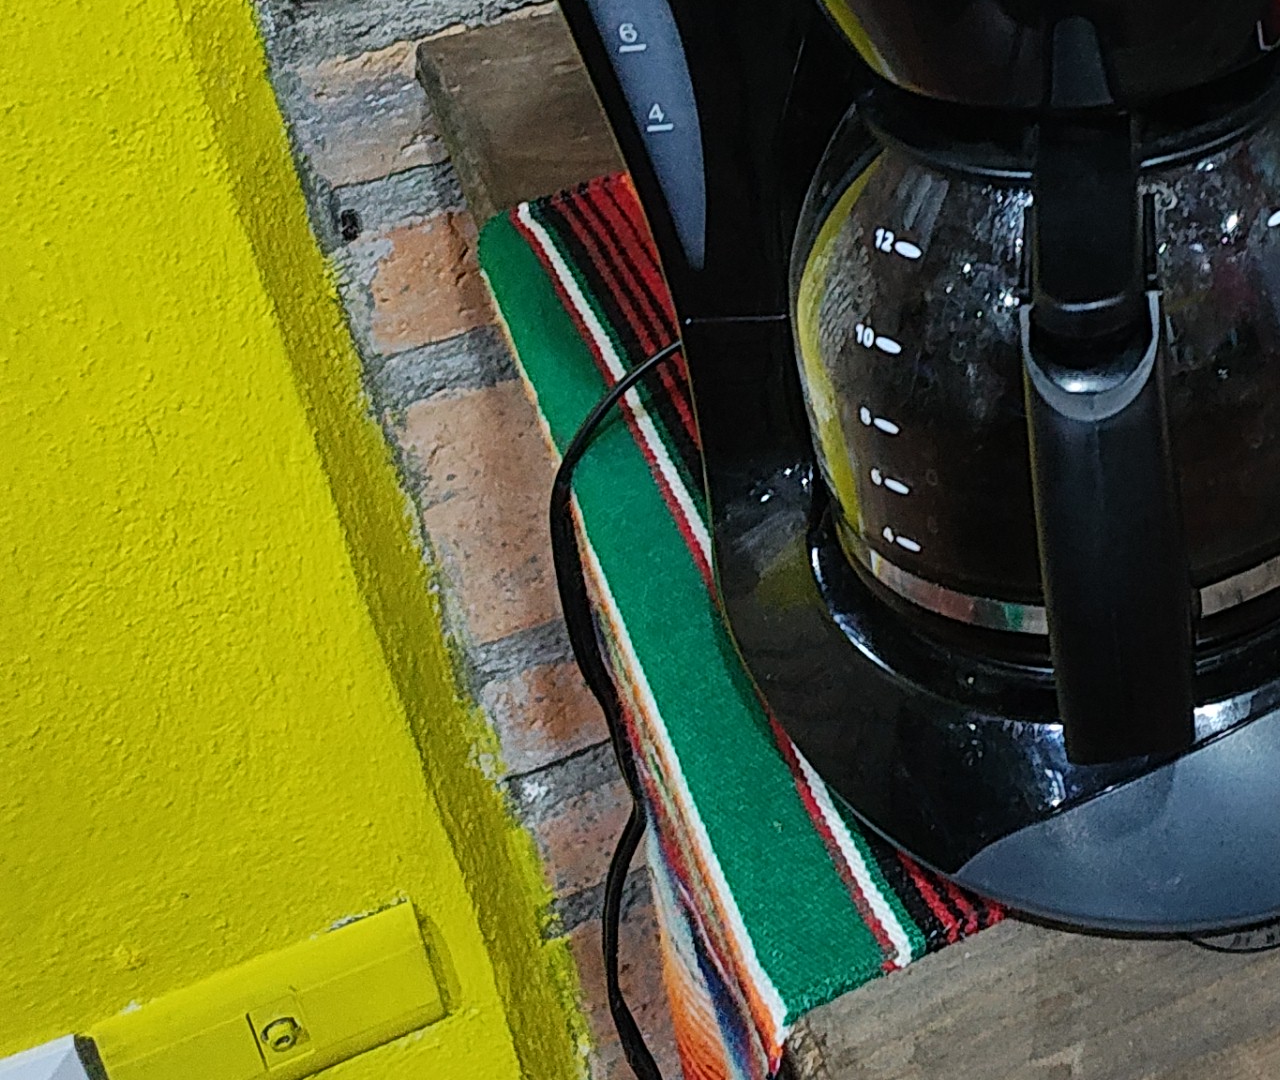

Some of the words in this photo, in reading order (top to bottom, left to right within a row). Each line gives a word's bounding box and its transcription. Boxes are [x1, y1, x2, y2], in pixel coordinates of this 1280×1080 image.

[618, 22, 638, 44] 6
[648, 102, 665, 123] 4
[874, 227, 895, 254] 12
[854, 322, 876, 348] 10
